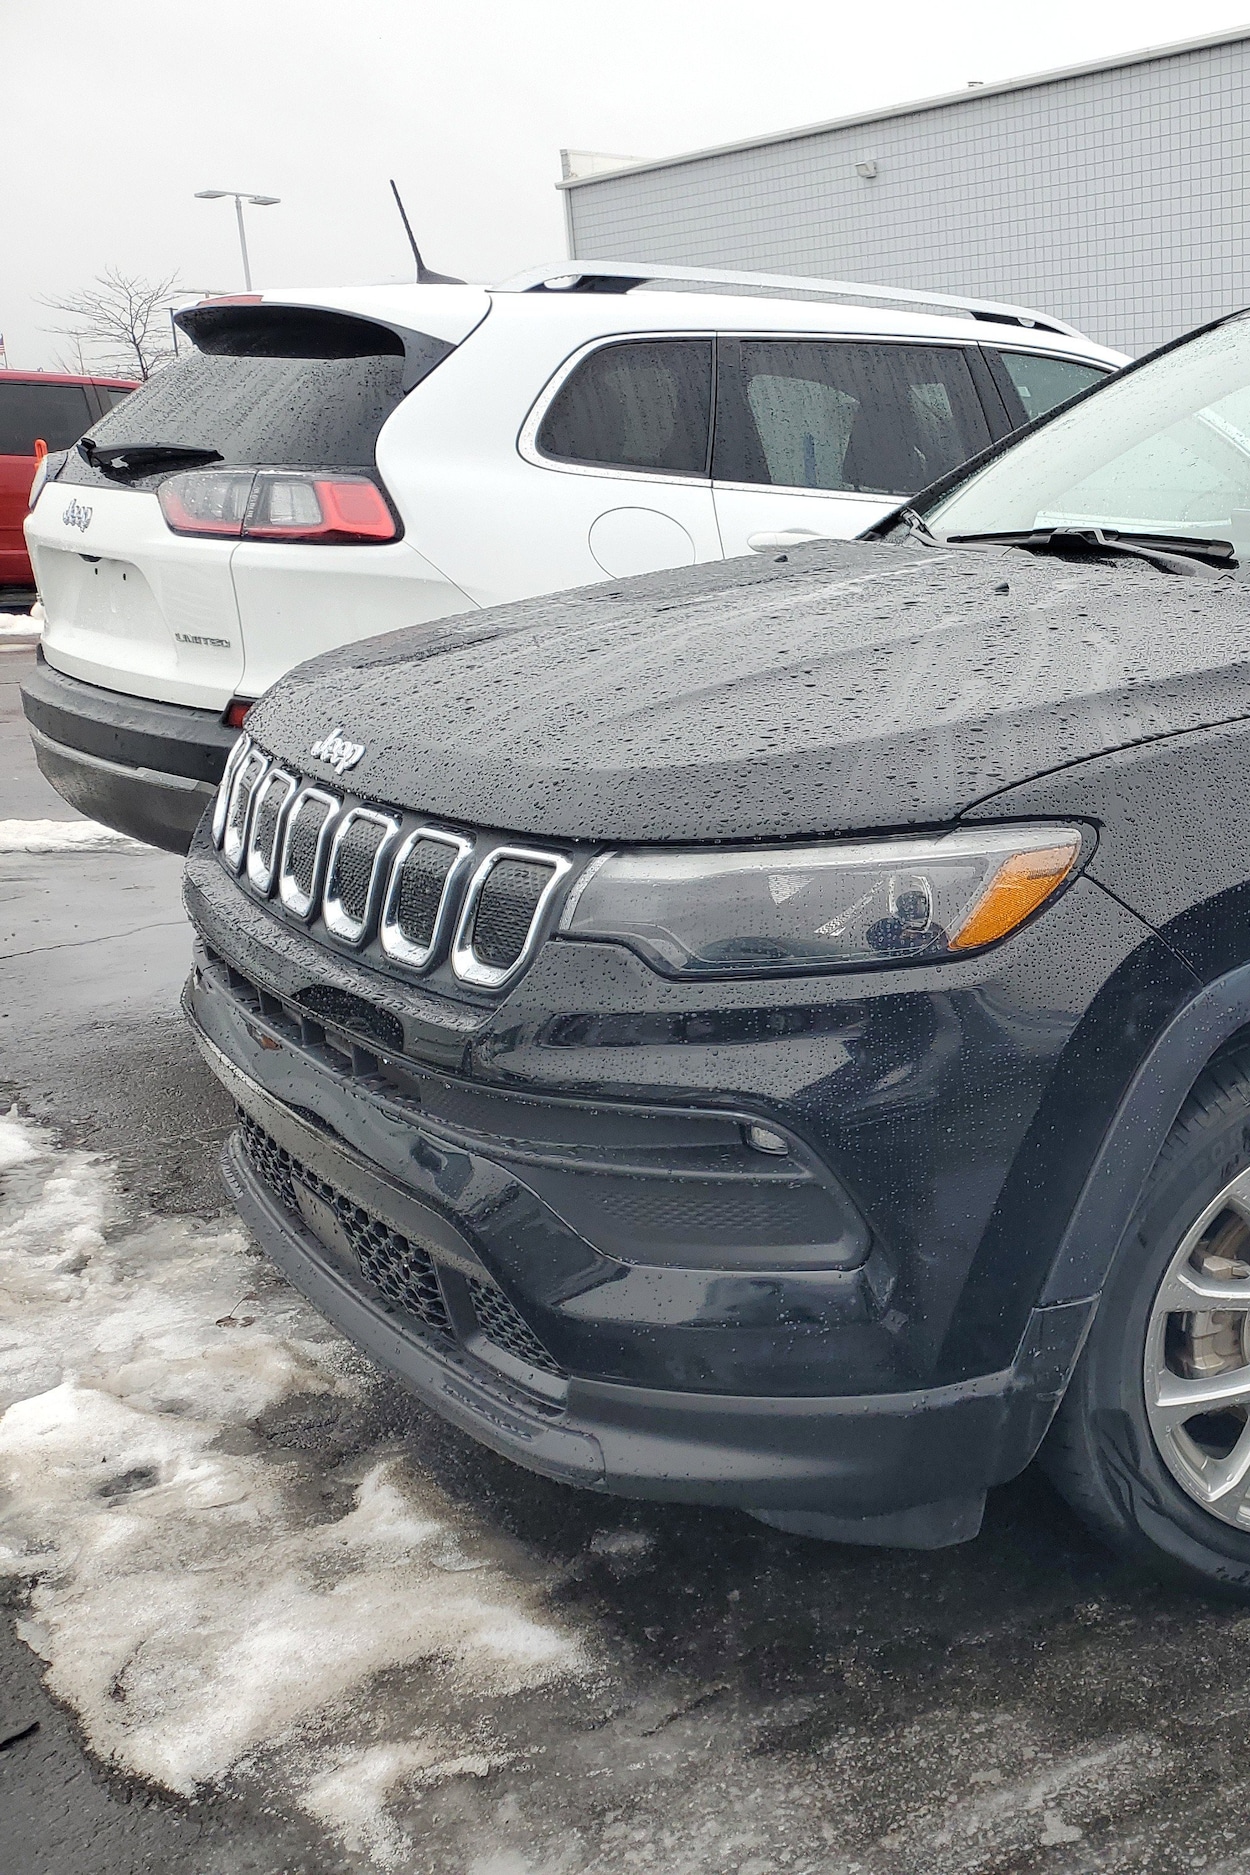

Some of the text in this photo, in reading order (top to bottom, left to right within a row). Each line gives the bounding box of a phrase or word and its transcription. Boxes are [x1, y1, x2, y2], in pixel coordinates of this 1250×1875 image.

[62, 498, 93, 533] Jeep
[174, 632, 231, 648] LIMITED
[310, 728, 366, 776] Jeep
